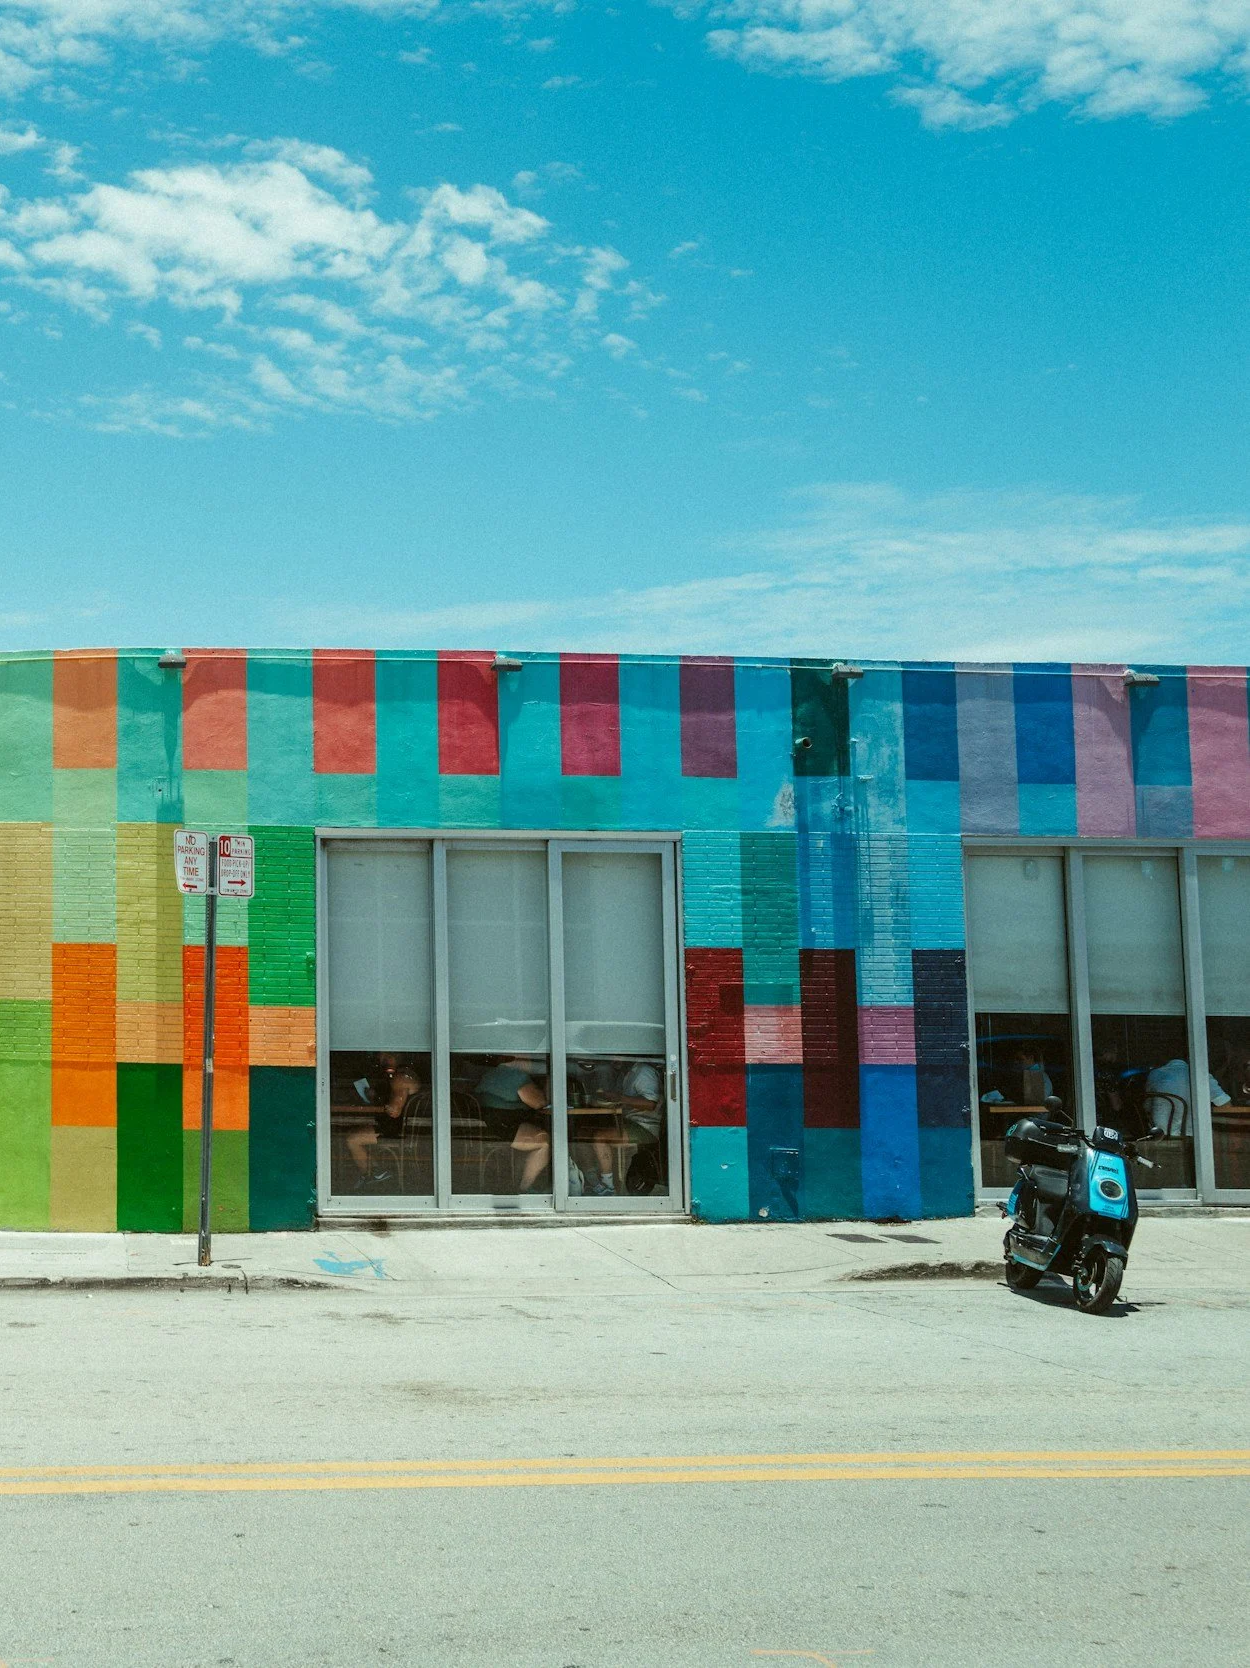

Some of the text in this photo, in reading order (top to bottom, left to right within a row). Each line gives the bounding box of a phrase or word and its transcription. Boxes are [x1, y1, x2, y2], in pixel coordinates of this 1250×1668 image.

[185, 836, 196, 845] NO
[177, 845, 205, 856] PARKING
[220, 840, 231, 855] 10
[232, 848, 251, 856] PARKING
[184, 856, 198, 865] ANY
[183, 866, 199, 876] TIME
